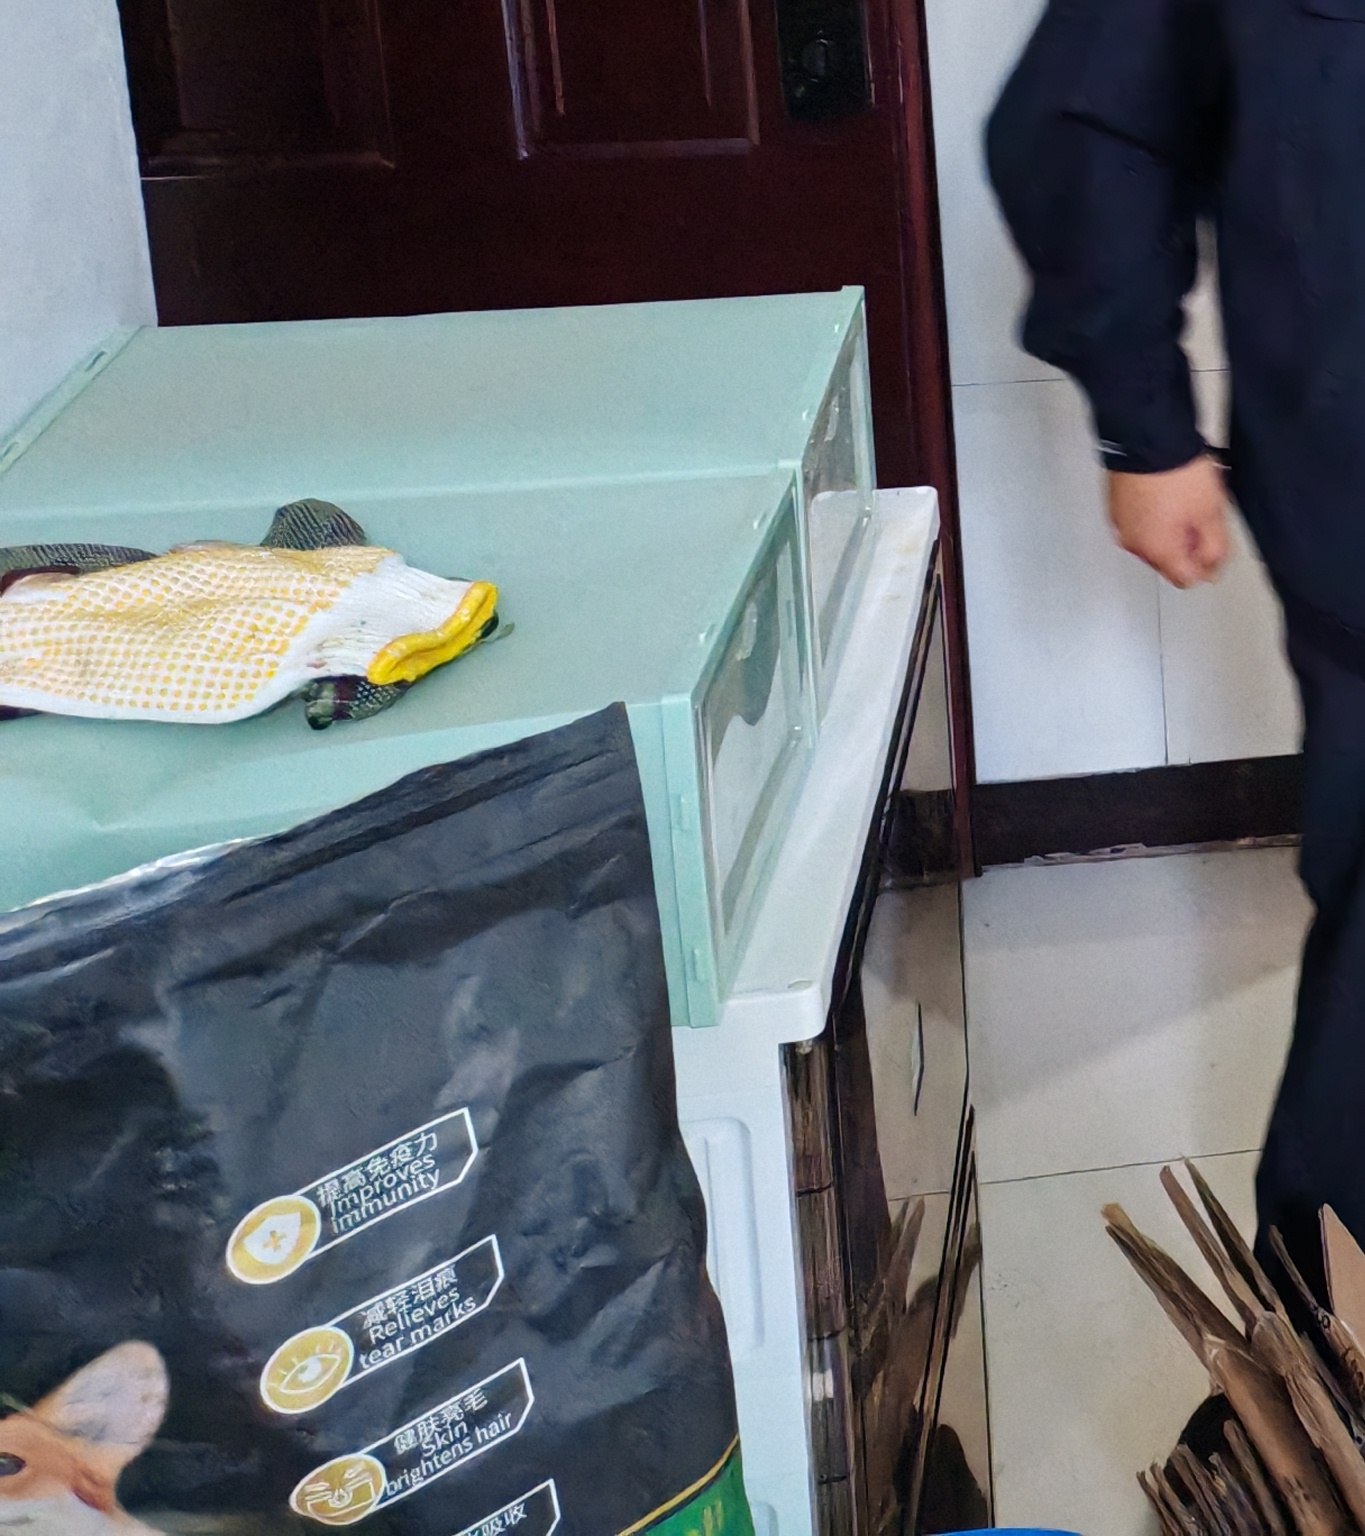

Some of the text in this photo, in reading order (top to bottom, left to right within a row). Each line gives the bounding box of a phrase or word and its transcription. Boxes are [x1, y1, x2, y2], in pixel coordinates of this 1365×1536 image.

[316, 1131, 438, 1207] 提高免疫力
[330, 1153, 436, 1217] Improves
[331, 1168, 440, 1234] immunity
[360, 1264, 458, 1330] 减轻泪痕
[368, 1286, 461, 1345] Relieves
[358, 1296, 477, 1370] tear marks
[384, 1411, 512, 1497] brightens hair
[420, 1420, 468, 1457] Skin
